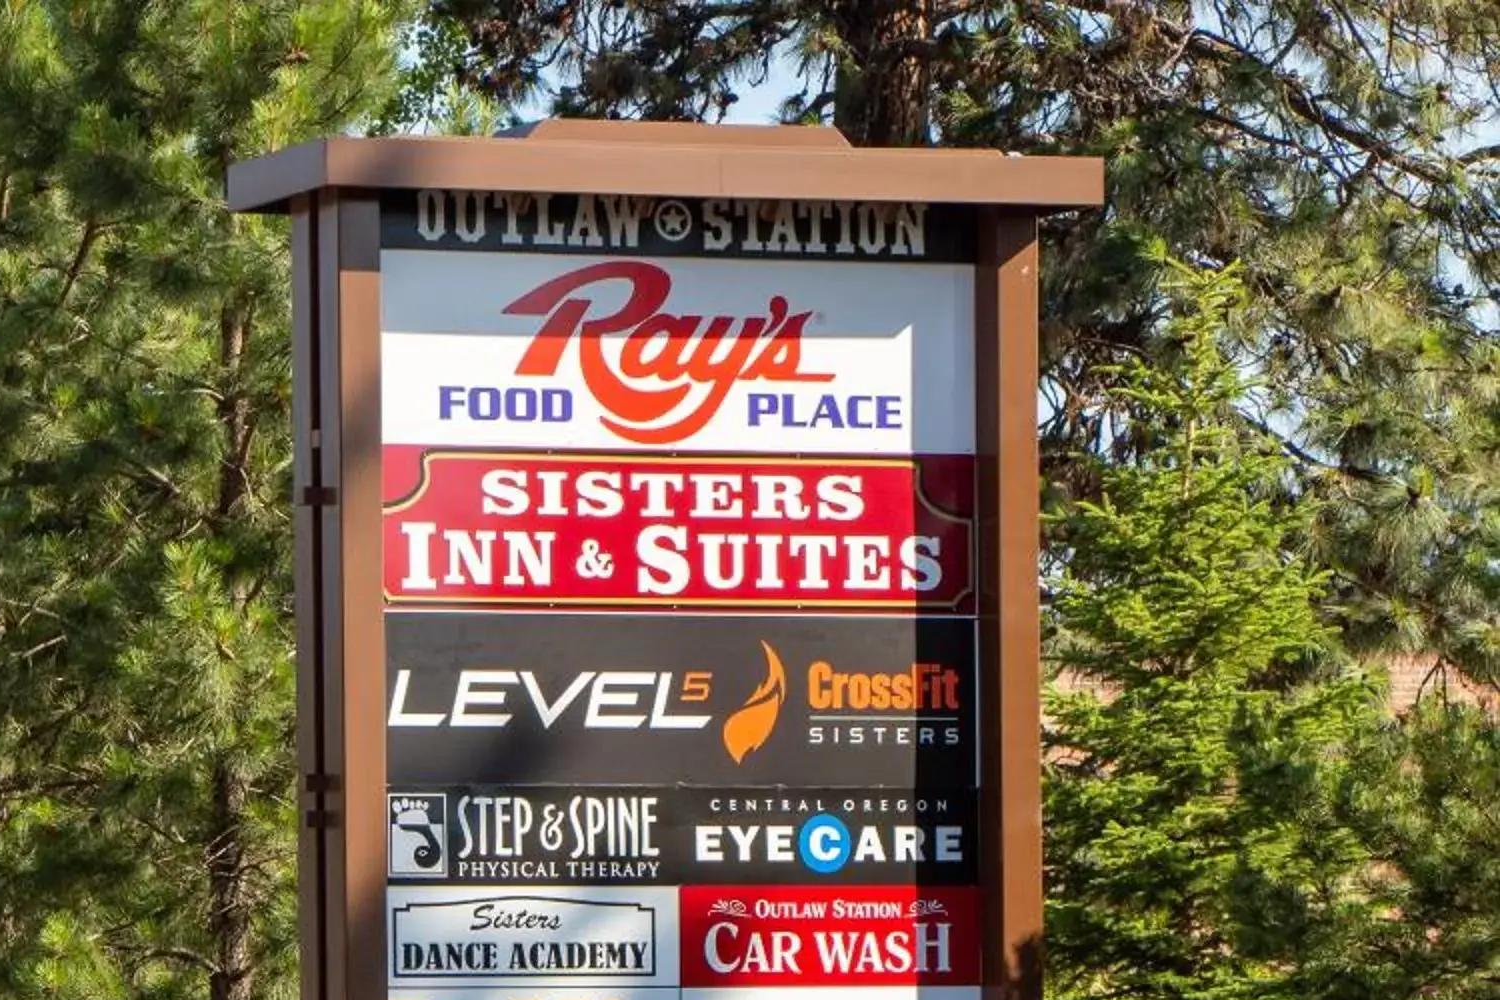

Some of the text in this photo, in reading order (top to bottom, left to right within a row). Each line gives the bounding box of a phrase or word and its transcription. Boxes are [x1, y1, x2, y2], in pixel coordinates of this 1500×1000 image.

[416, 189, 928, 256] OUTLAW STATION
[501, 260, 836, 445] Ray's
[438, 385, 903, 429] FOOD PLACE
[481, 469, 864, 521] SISTERS
[576, 539, 615, 580] &
[807, 660, 959, 710] CrossFit
[808, 727, 960, 744] SISTERS
[709, 799, 949, 812] CENTRAL OREGON
[457, 795, 661, 859] STEP & SPINE
[458, 861, 660, 878] PHYSICAL THERAPY
[469, 903, 562, 932] Sisters
[402, 941, 648, 971] DANCE ACADEMY
